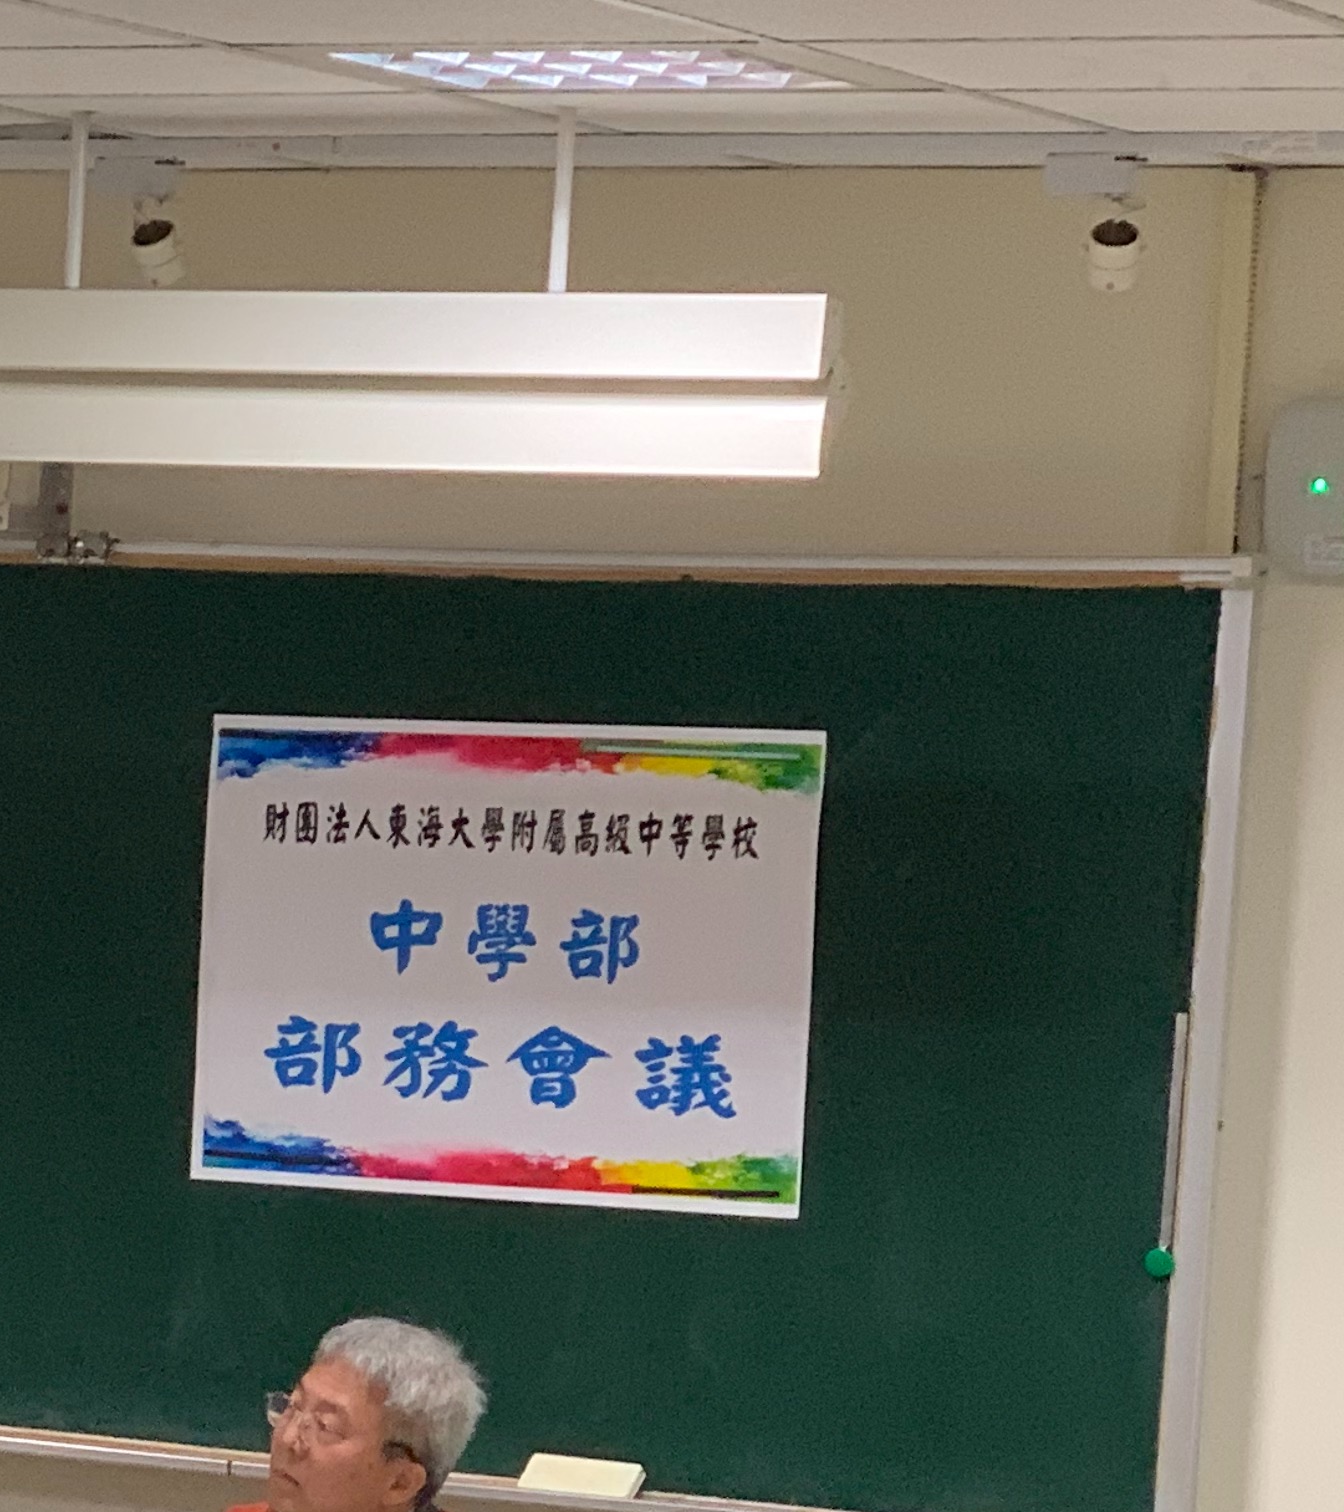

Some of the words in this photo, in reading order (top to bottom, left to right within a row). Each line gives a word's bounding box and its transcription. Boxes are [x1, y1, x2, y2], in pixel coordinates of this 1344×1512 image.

[263, 801, 760, 861] 財團法人東海大學附屬高級中等學校
[369, 899, 641, 985] 中學部
[263, 1014, 738, 1120] 部務會議
